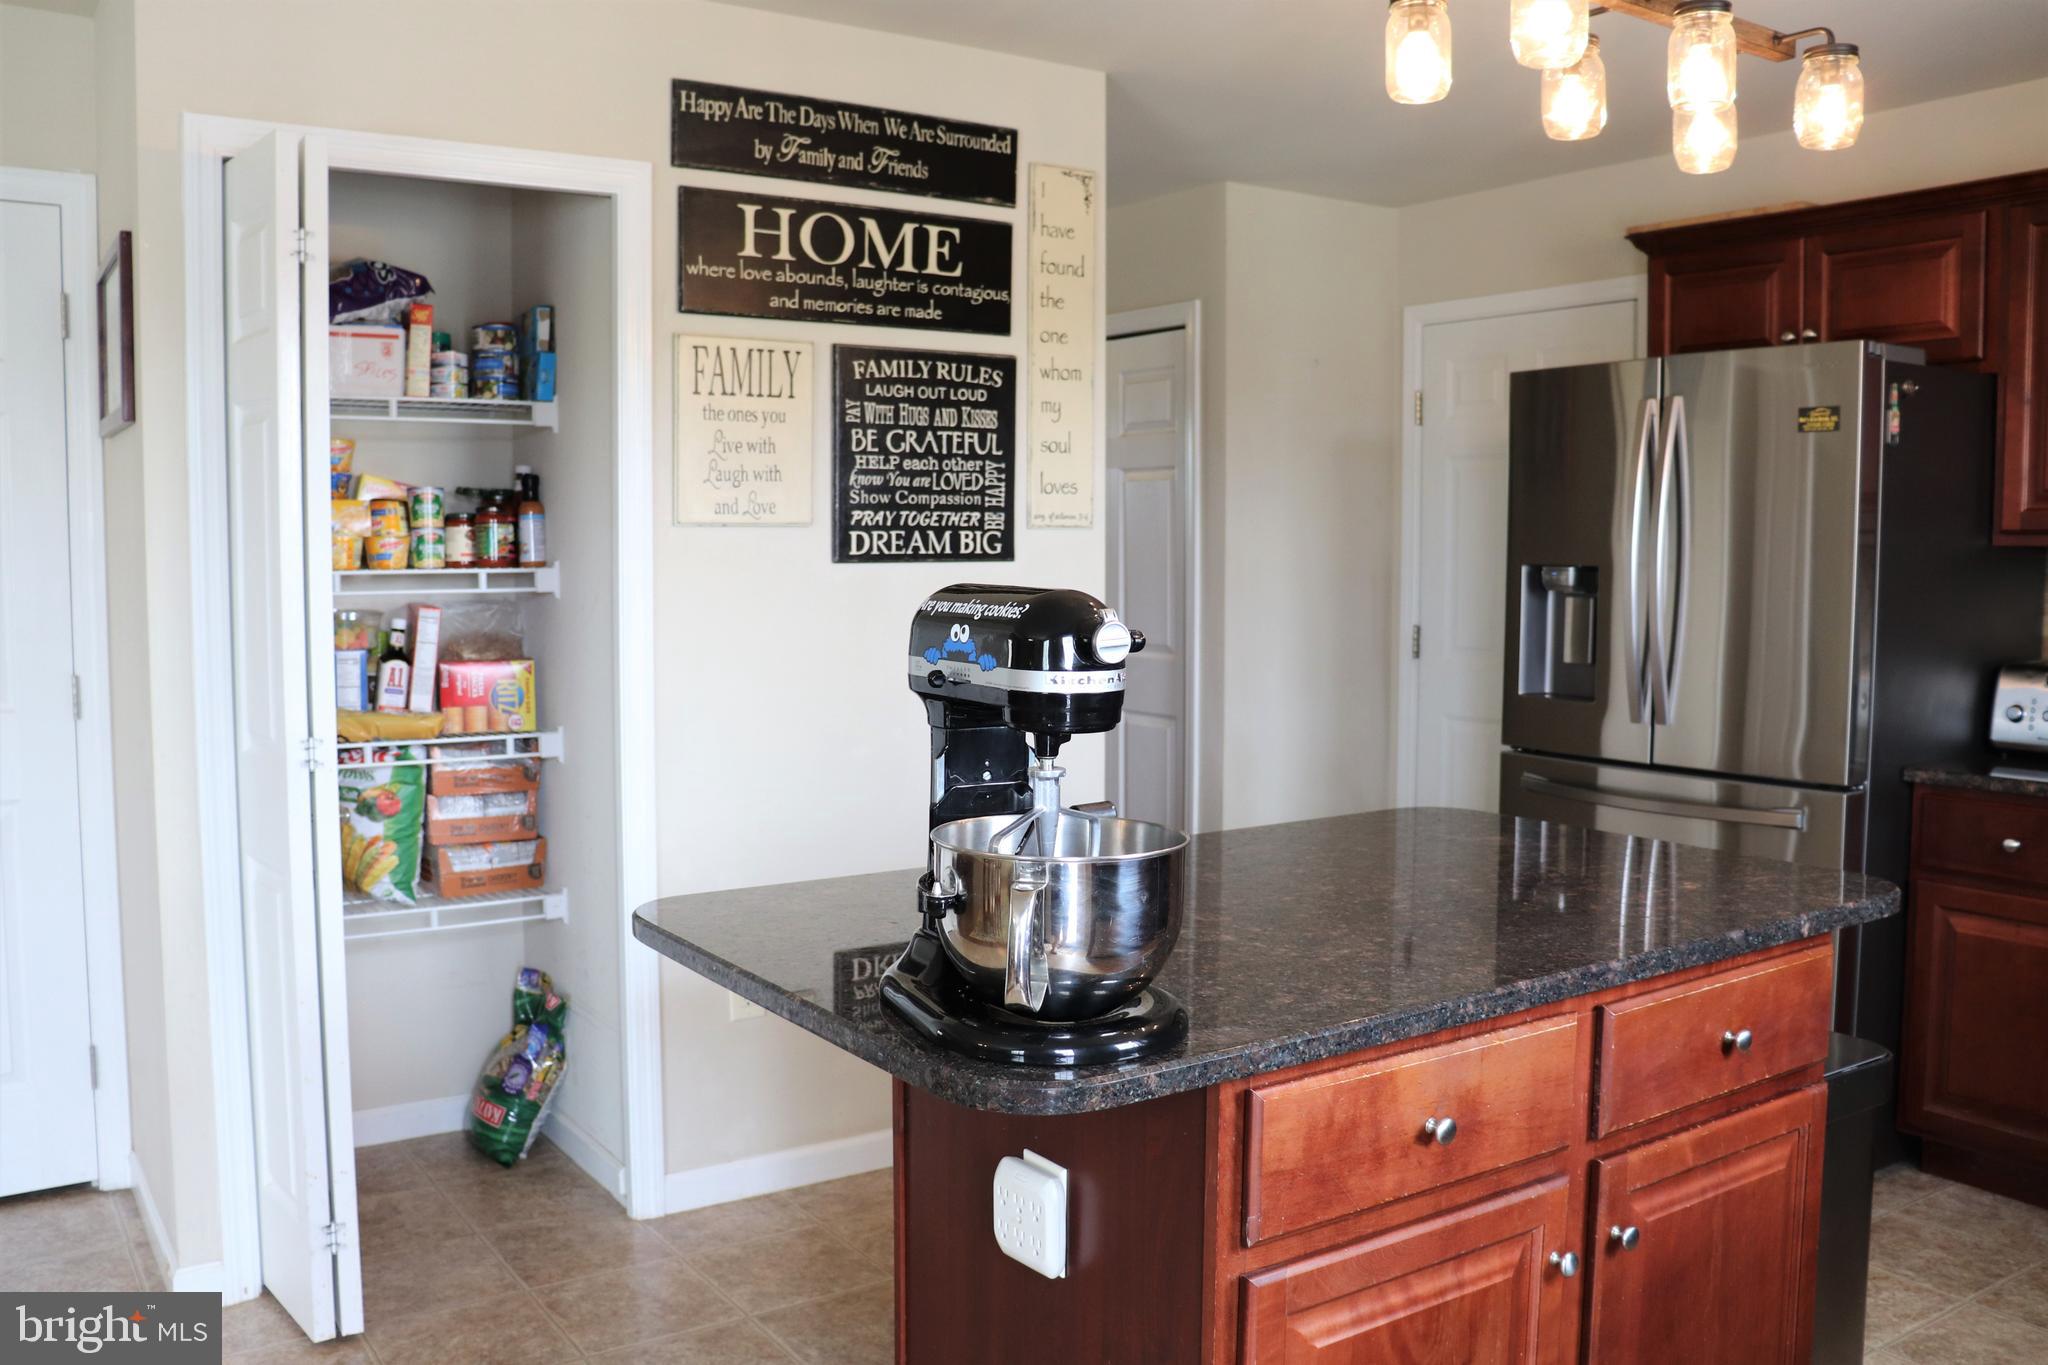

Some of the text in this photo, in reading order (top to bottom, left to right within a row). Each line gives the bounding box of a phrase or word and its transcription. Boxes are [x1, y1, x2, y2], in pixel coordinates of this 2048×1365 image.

[680, 90, 1012, 154] Happy Are The Days When We Are Surrounded
[754, 133, 929, 180] by Family and Friends
[1041, 181, 1046, 199] I
[1040, 212, 1076, 240] have
[736, 203, 963, 278] HOME
[685, 255, 736, 278] where
[740, 259, 772, 281] love
[776, 263, 848, 290] abounds,
[852, 268, 914, 297] laughter
[916, 280, 929, 294] is
[1040, 250, 1085, 278] found
[769, 289, 943, 320] and memories are made
[1040, 284, 1064, 310] the
[1040, 330, 1068, 345] one
[692, 345, 802, 399] FAMILY
[852, 359, 1004, 388] FAMILY RULES
[1040, 356, 1082, 382] whom
[866, 384, 988, 402] LAUGH OUT LOUD
[702, 403, 786, 428] the ones you
[845, 399, 860, 423] PAY
[934, 408, 958, 427] AND
[1041, 400, 1062, 424] my
[708, 429, 776, 461] Live with
[851, 428, 1004, 456] BE GRATEFUL
[1040, 430, 1072, 454] soul
[703, 458, 782, 489] Laugh with
[854, 455, 984, 472] HELP each other
[886, 472, 910, 487] You
[912, 476, 932, 487] are
[932, 472, 984, 491] LOVED
[984, 460, 1006, 530] BE HAPPY
[1040, 470, 1078, 494] loves
[714, 490, 776, 520] and Love
[850, 490, 982, 509] Show Compassion
[850, 510, 981, 527] PRAY TOGETHER
[848, 530, 1003, 556] DREAM BIG
[931, 600, 951, 616] you
[949, 599, 986, 620] making
[984, 602, 1030, 619] cookies?
